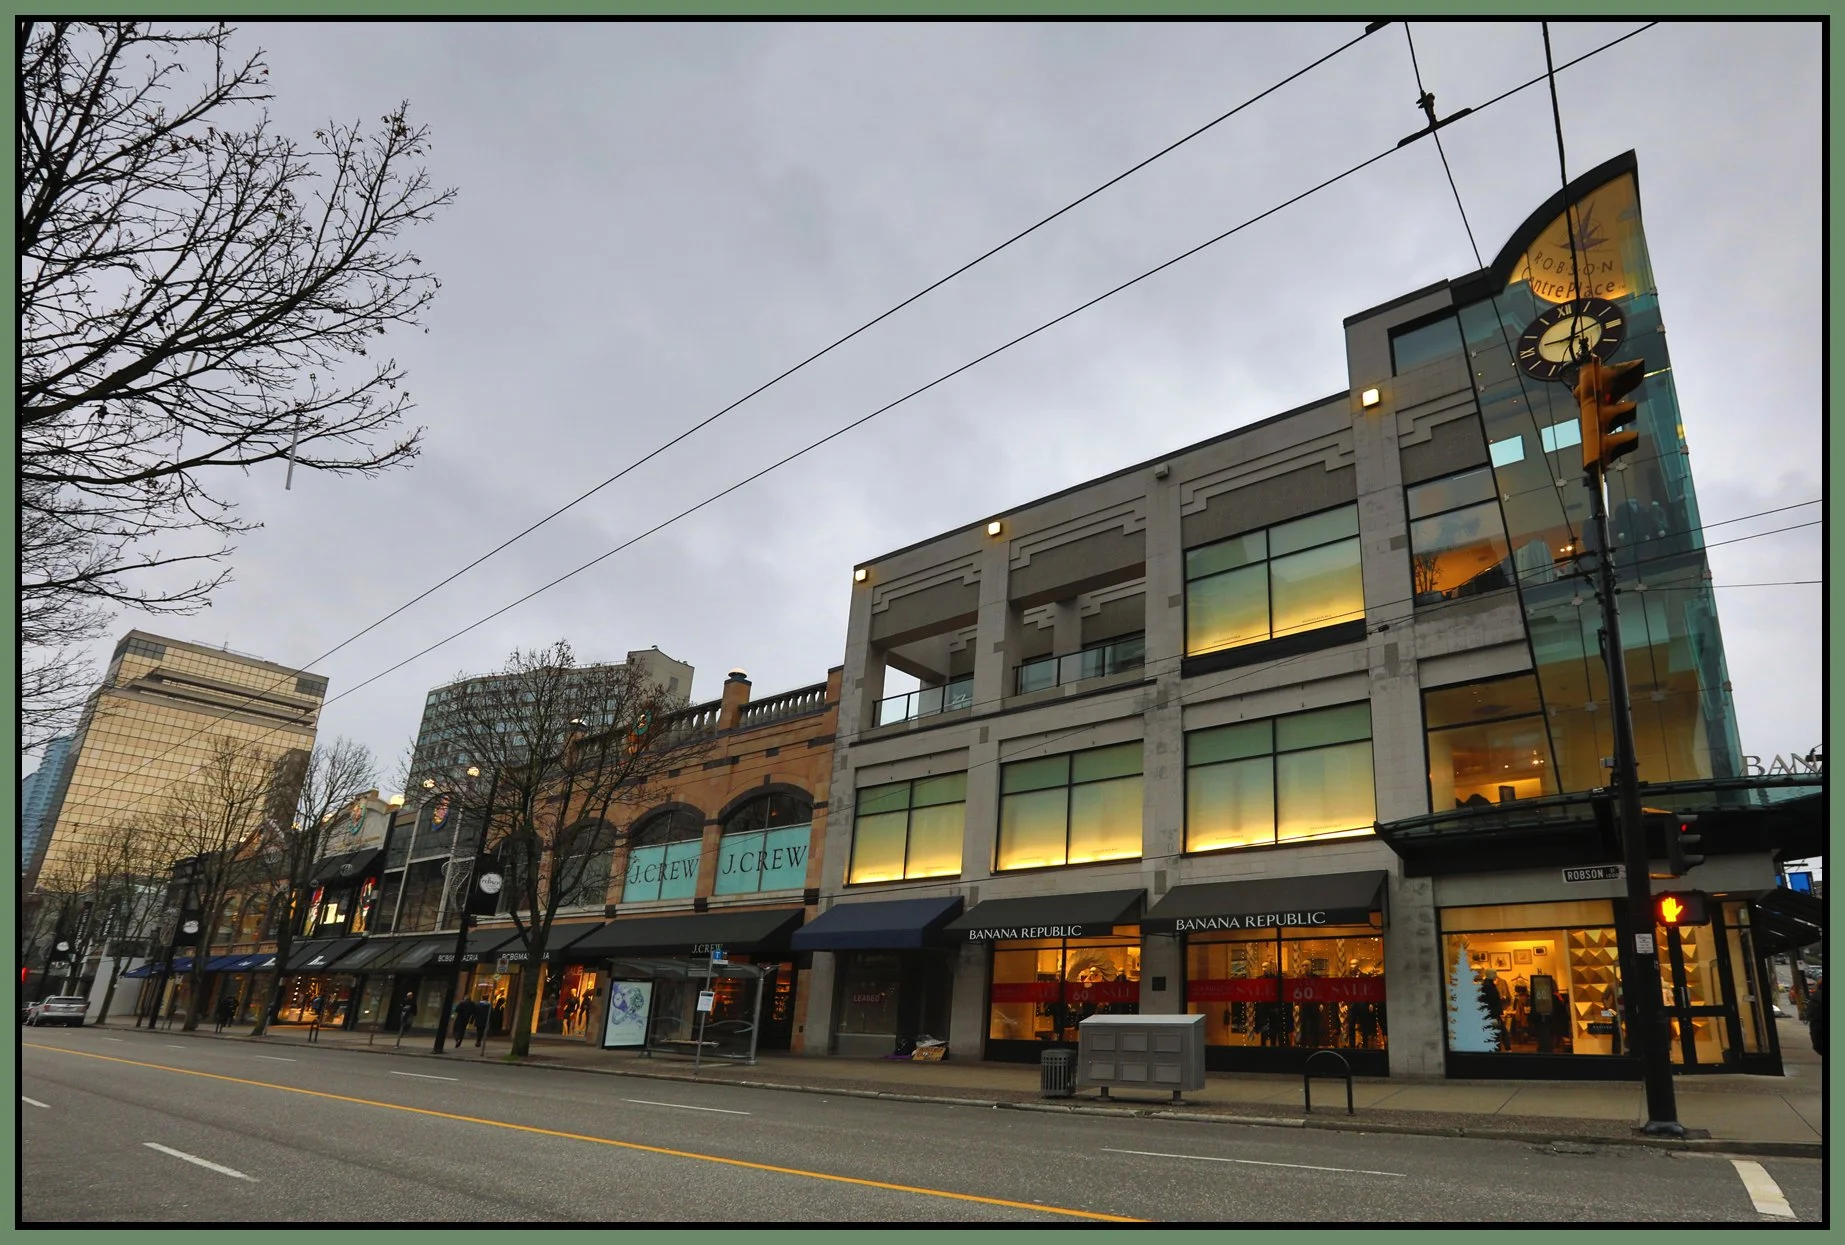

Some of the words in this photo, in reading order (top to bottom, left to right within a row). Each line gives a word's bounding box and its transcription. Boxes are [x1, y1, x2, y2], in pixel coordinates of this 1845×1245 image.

[722, 846, 808, 875] J.CREW
[630, 858, 699, 885] J.CREW
[1567, 869, 1604, 881] ROBSON
[1176, 917, 1240, 931] BANANA
[1245, 911, 1326, 928] REPUBLIC
[969, 928, 1018, 940] BANANA
[1021, 925, 1082, 938] REPUBLIC
[692, 943, 723, 954] J.CREW
[1293, 987, 1314, 1000] 60
